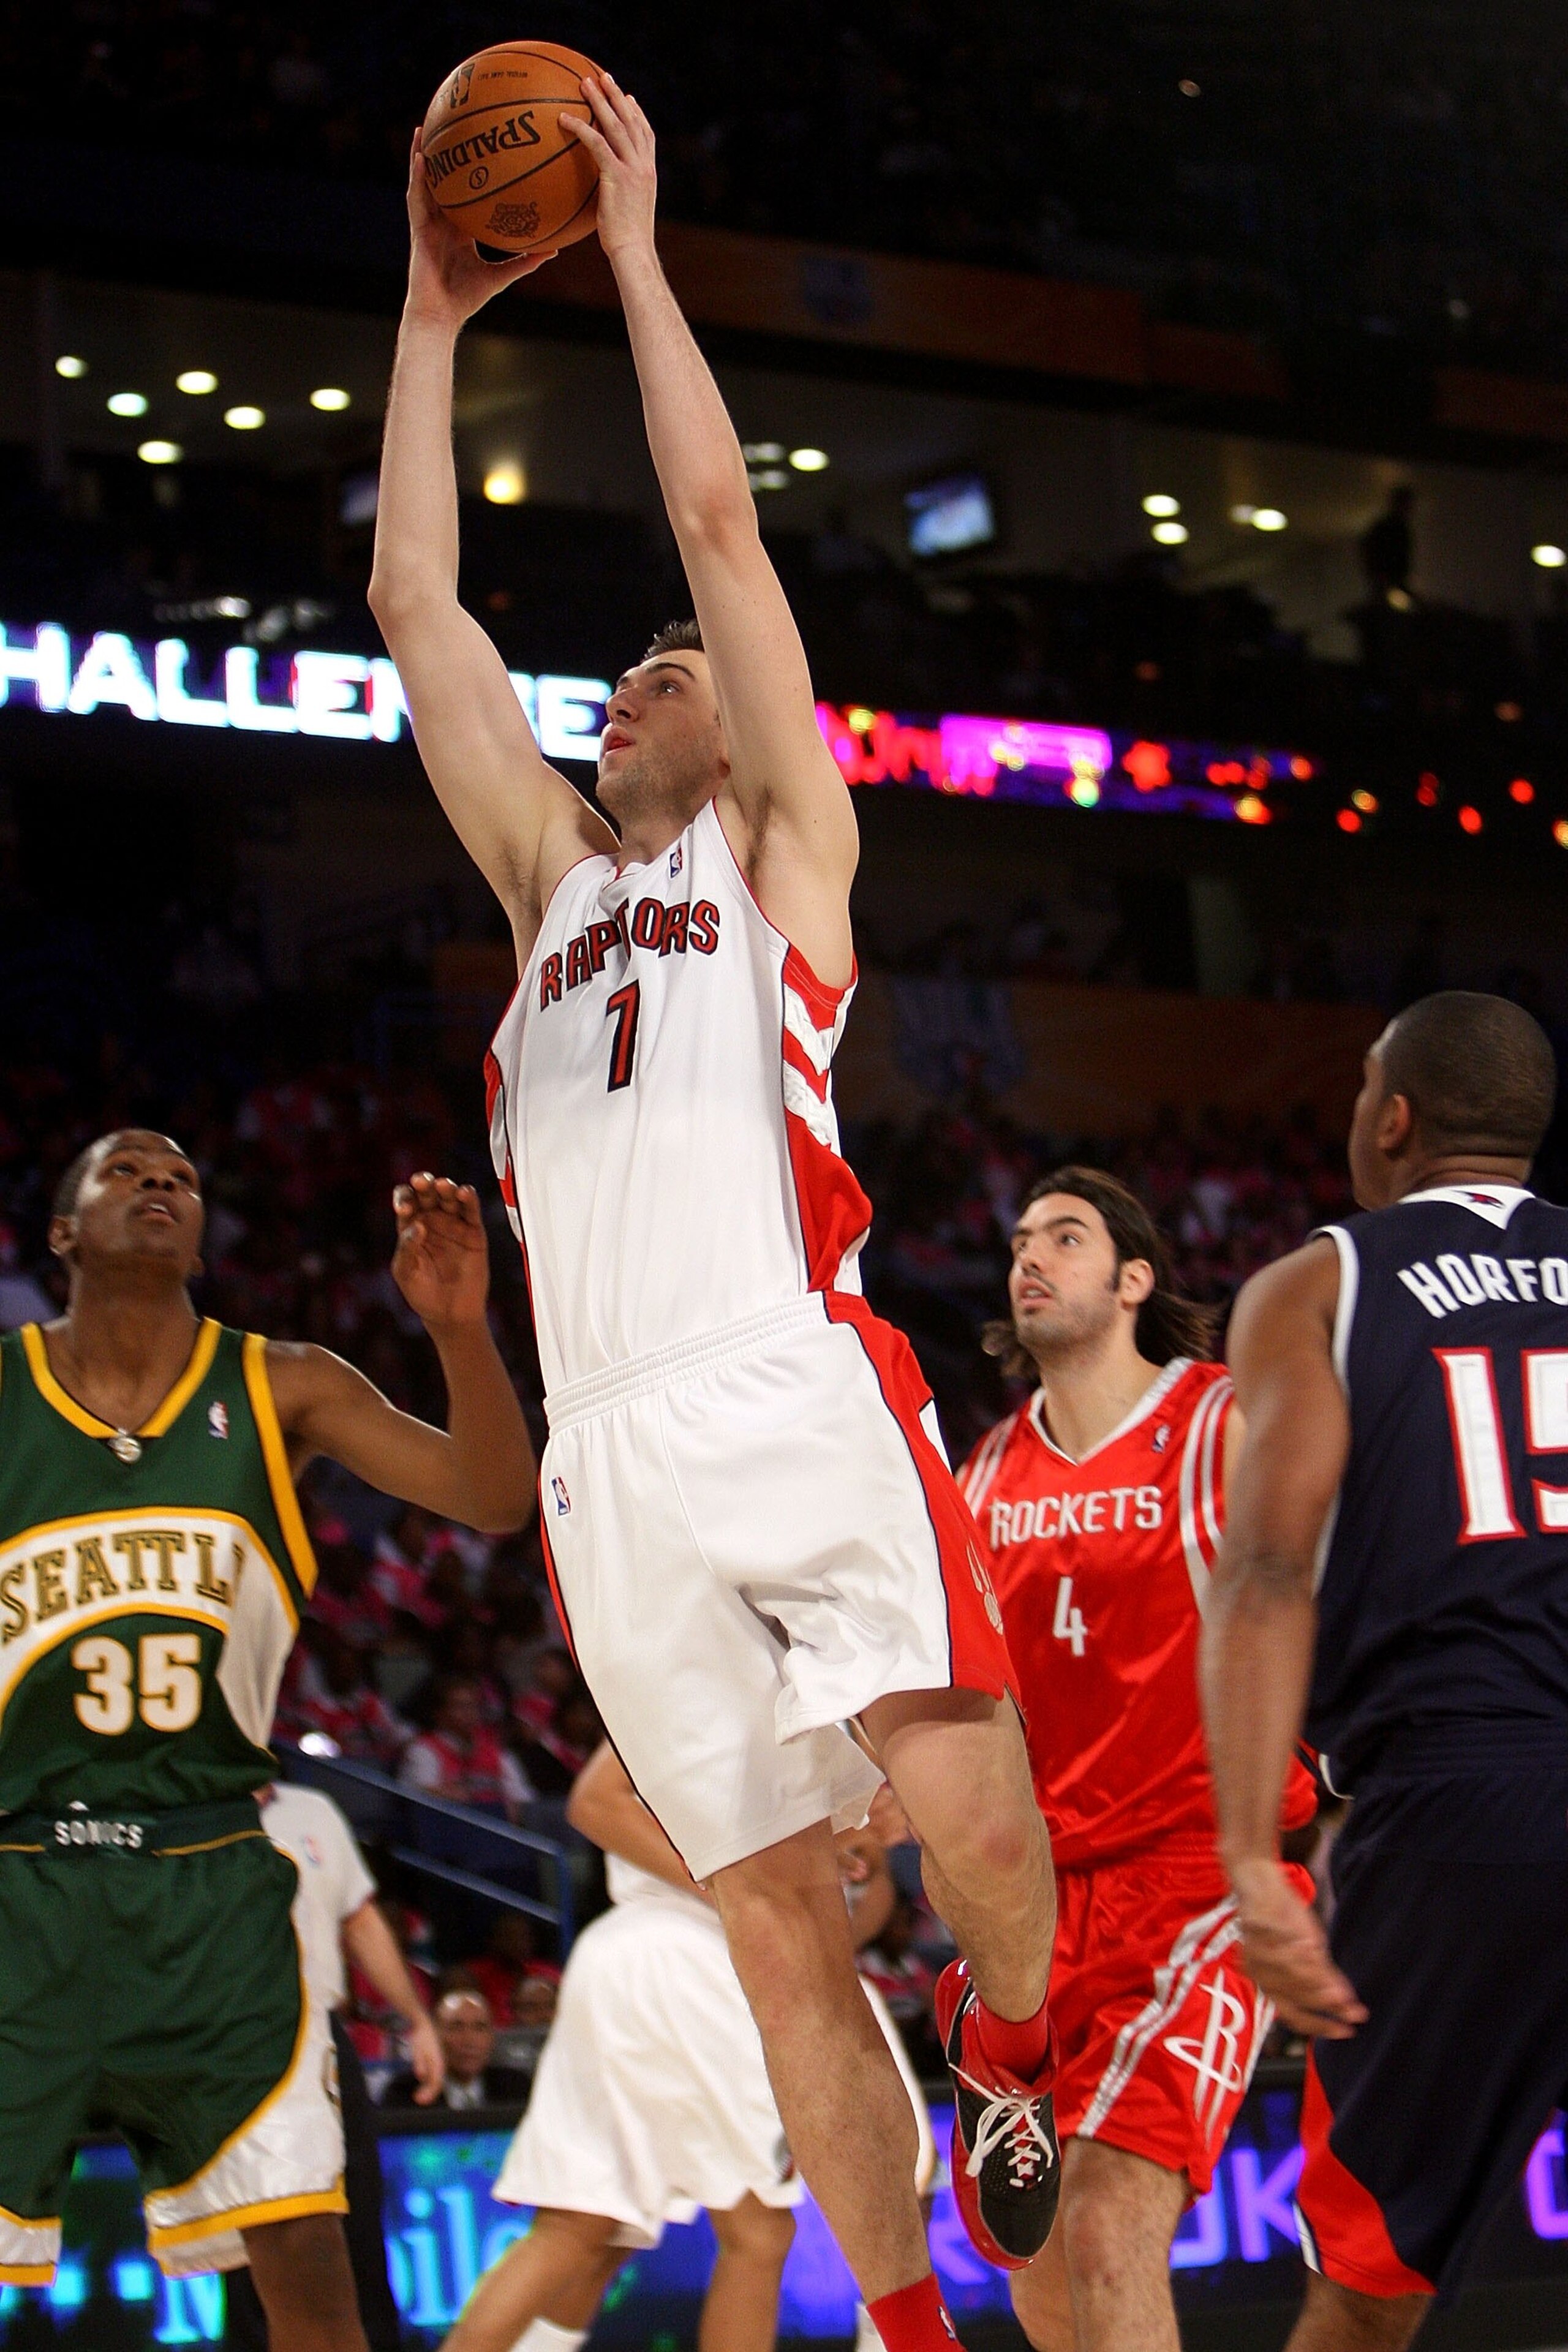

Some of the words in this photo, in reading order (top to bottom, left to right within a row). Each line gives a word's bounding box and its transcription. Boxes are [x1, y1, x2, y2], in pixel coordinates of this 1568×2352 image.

[427, 110, 541, 189] SPALDING
[0, 622, 611, 761] HALLENE
[540, 897, 721, 1012] RAPTORS
[605, 979, 640, 1093] 7
[1396, 1253, 1568, 1319] HORFO
[1431, 1347, 1568, 1545] 15
[988, 1485, 1163, 1551] ROCKETS
[0, 1530, 244, 1646] SEATTL
[1052, 1576, 1088, 1657] 4
[70, 1633, 202, 1736] 35
[54, 1820, 144, 1849] SONICS
